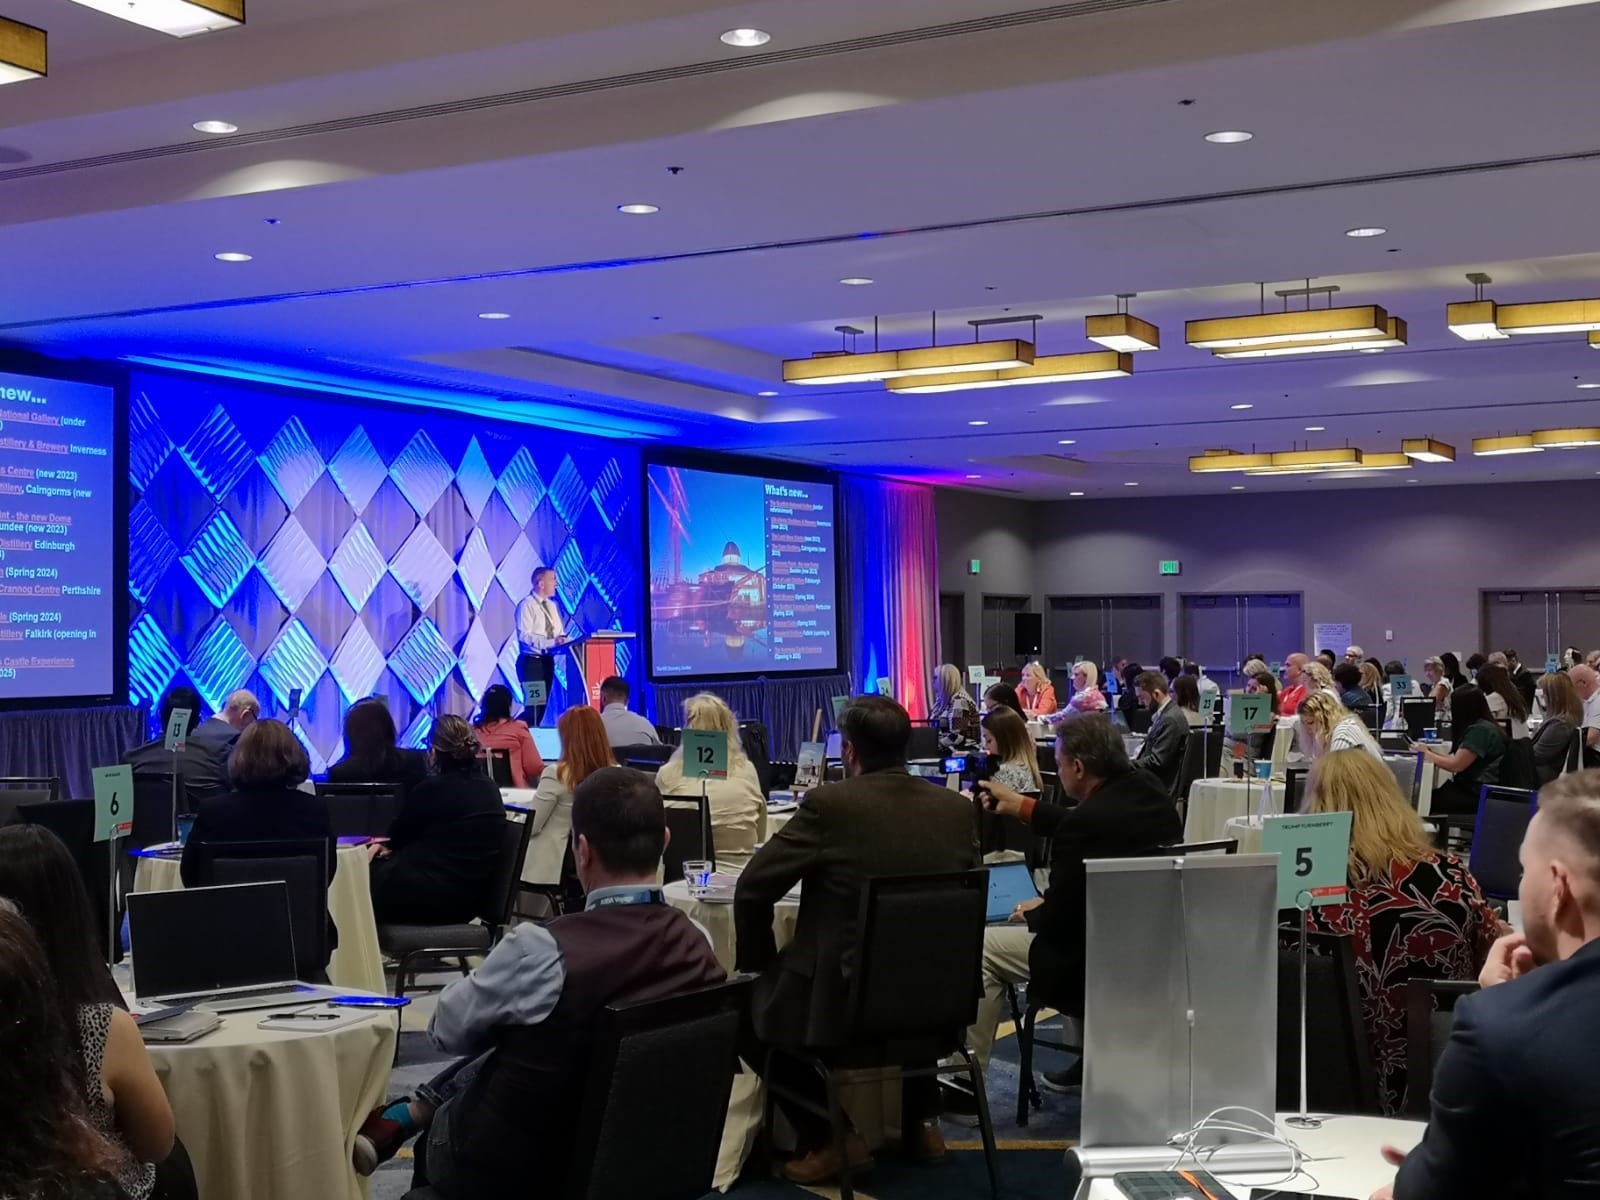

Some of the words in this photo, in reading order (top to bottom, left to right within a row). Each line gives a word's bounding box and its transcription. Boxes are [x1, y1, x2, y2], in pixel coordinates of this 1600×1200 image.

[61, 416, 86, 427] (under
[70, 444, 107, 456] Inverness
[36, 468, 55, 479] (new
[26, 484, 71, 497] Cairngorms
[73, 488, 92, 499] (new
[765, 484, 788, 497] What's
[34, 540, 75, 552] Edinburgh
[5, 567, 35, 578] (Spring
[36, 568, 58, 579] 2024)
[62, 585, 101, 595] Perthshire
[9, 611, 39, 623] (Spring
[40, 612, 62, 623] 2024)
[25, 629, 52, 638] Falkirk
[54, 629, 88, 640] (opening
[89, 629, 96, 638] in
[529, 689, 540, 698] 25
[1243, 706, 1259, 721] 17
[696, 746, 714, 764] 12
[110, 791, 119, 816] 6
[1294, 846, 1313, 877] 5
